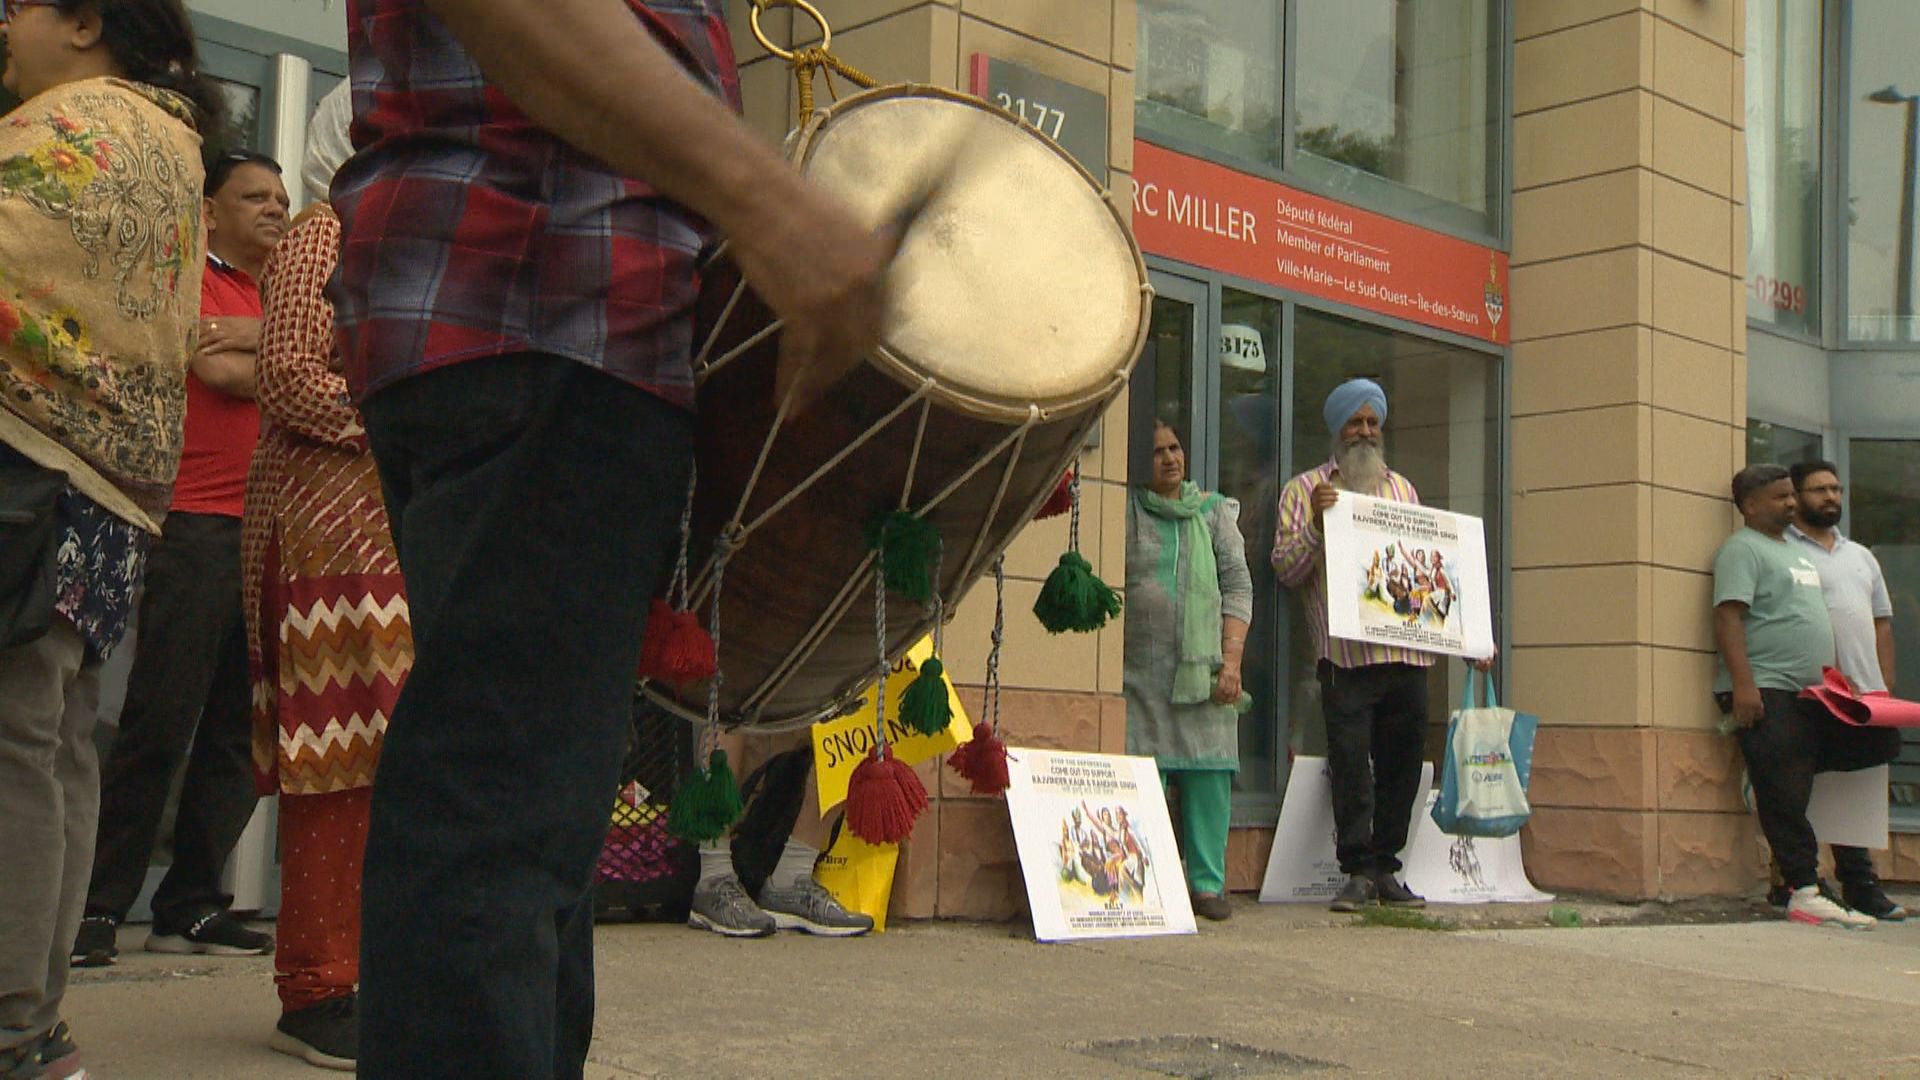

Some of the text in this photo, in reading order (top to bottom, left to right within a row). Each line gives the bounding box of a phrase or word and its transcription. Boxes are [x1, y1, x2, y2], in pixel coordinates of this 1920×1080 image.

[1167, 188, 1257, 245] MILLER
[1277, 198, 1353, 235] Député fédéral
[1277, 228, 1391, 274] Member of Parliament
[1220, 336, 1260, 358] 3175
[1390, 512, 1403, 522] OUT
[1404, 515, 1412, 524] TO
[1050, 766, 1116, 779] COME OUT TO SUPPORT
